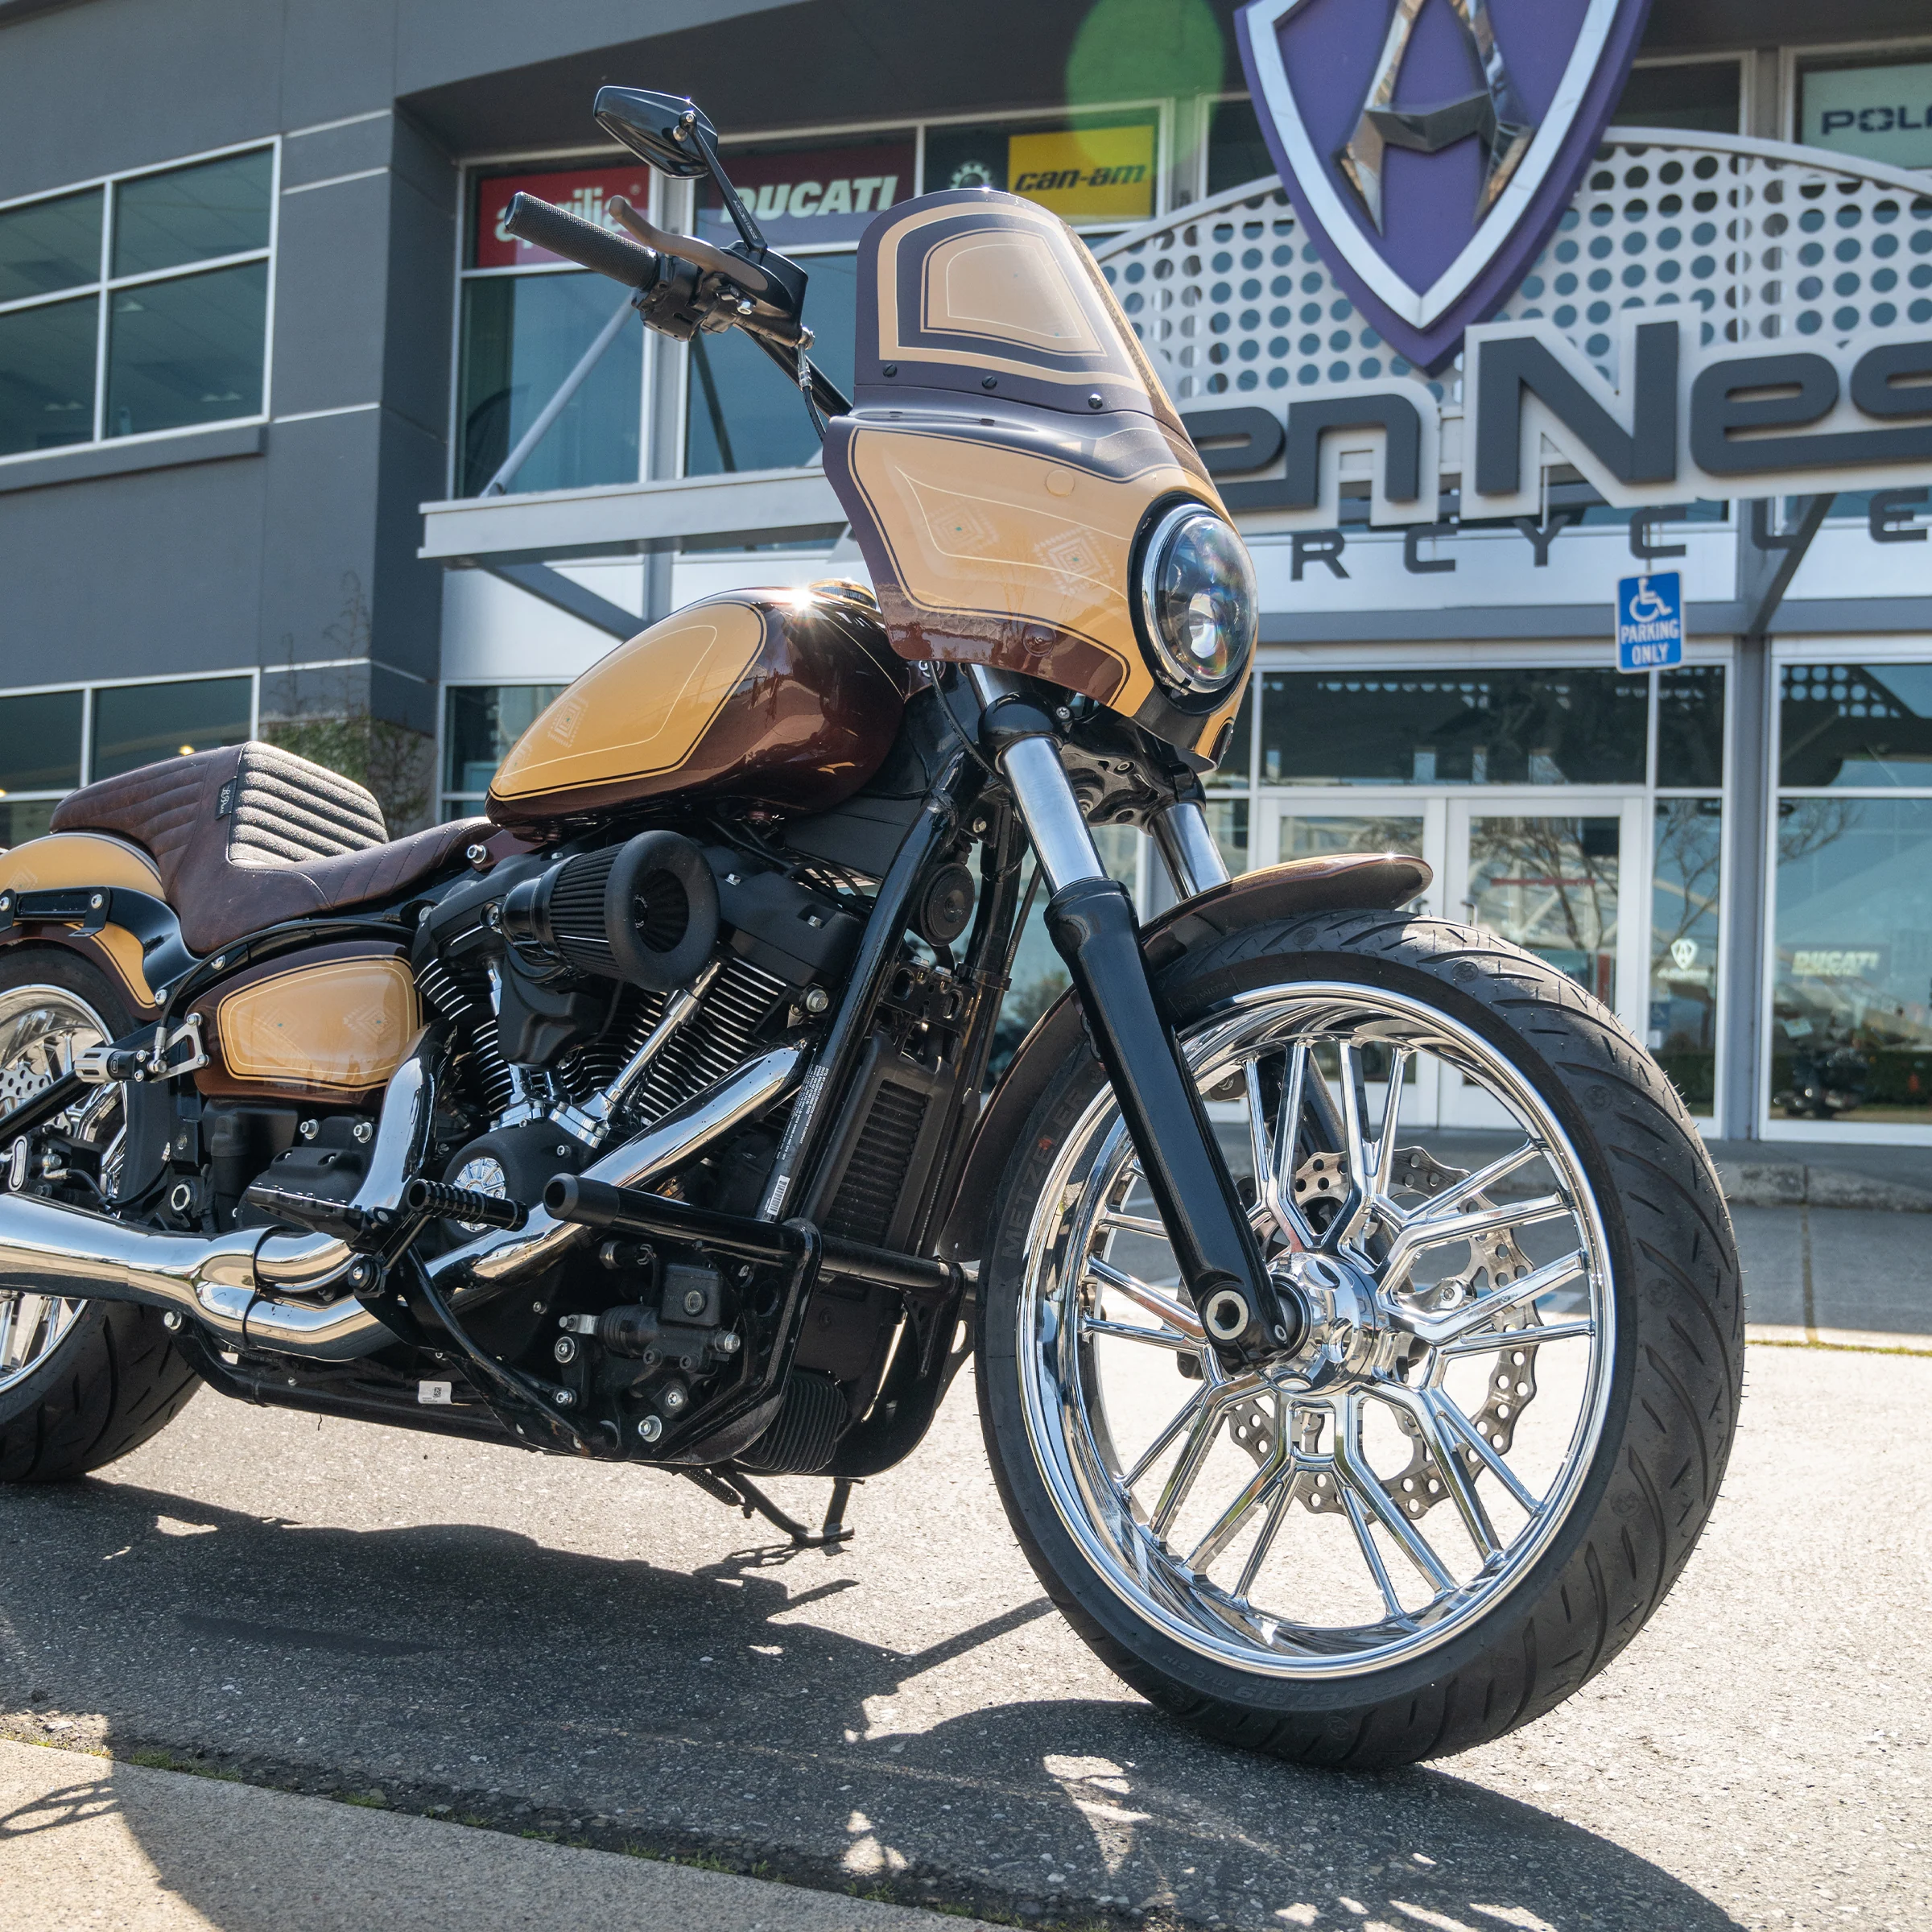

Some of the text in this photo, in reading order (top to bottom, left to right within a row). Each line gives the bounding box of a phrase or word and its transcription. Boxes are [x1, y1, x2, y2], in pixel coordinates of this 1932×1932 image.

[1014, 165, 1146, 192] can-am
[720, 175, 899, 223] DUCATI
[1177, 319, 1932, 514] en Nes
[1620, 618, 1680, 645] PARKING
[1632, 642, 1669, 666] ONLY
[1792, 951, 1879, 972] DUCATI
[804, 1113, 812, 1127] MOTOR
[799, 1125, 807, 1144] COMPANY
[1001, 1087, 1091, 1261] METZELER
